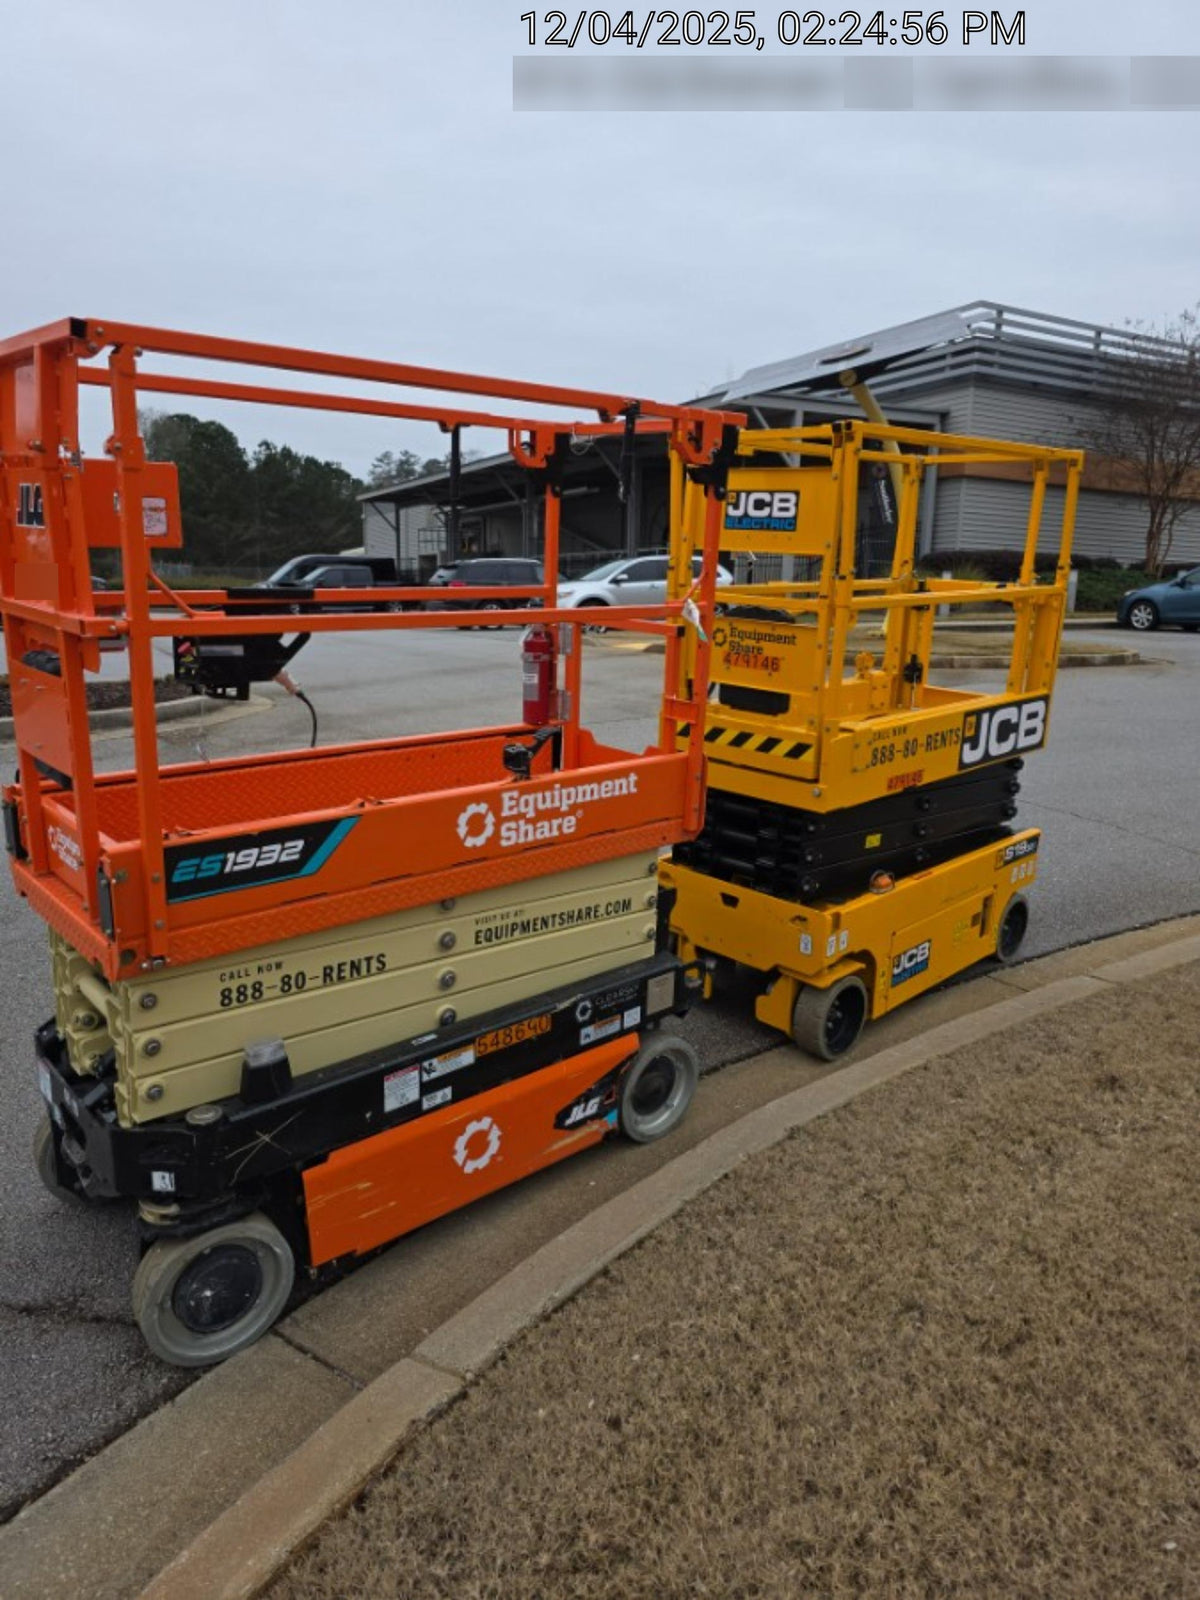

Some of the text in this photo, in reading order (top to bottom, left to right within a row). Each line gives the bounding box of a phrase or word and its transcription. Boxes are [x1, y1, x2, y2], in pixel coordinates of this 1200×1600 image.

[727, 491, 797, 519] JCB
[725, 517, 796, 530] ELECTRIC
[728, 640, 764, 655] Share
[729, 626, 797, 646] Equipment
[870, 726, 961, 767] 888-80-RENTS
[961, 699, 1047, 764] JCB
[501, 772, 638, 818] Equipment
[500, 815, 577, 847] Share
[171, 839, 305, 883] ES1932
[474, 898, 633, 945] EQUIPMENTSHARE.COM
[219, 961, 284, 983] CALL NOW
[893, 941, 930, 975] JCB
[219, 952, 388, 1008] 888-80-RENTS
[564, 1096, 601, 1127] JLG
